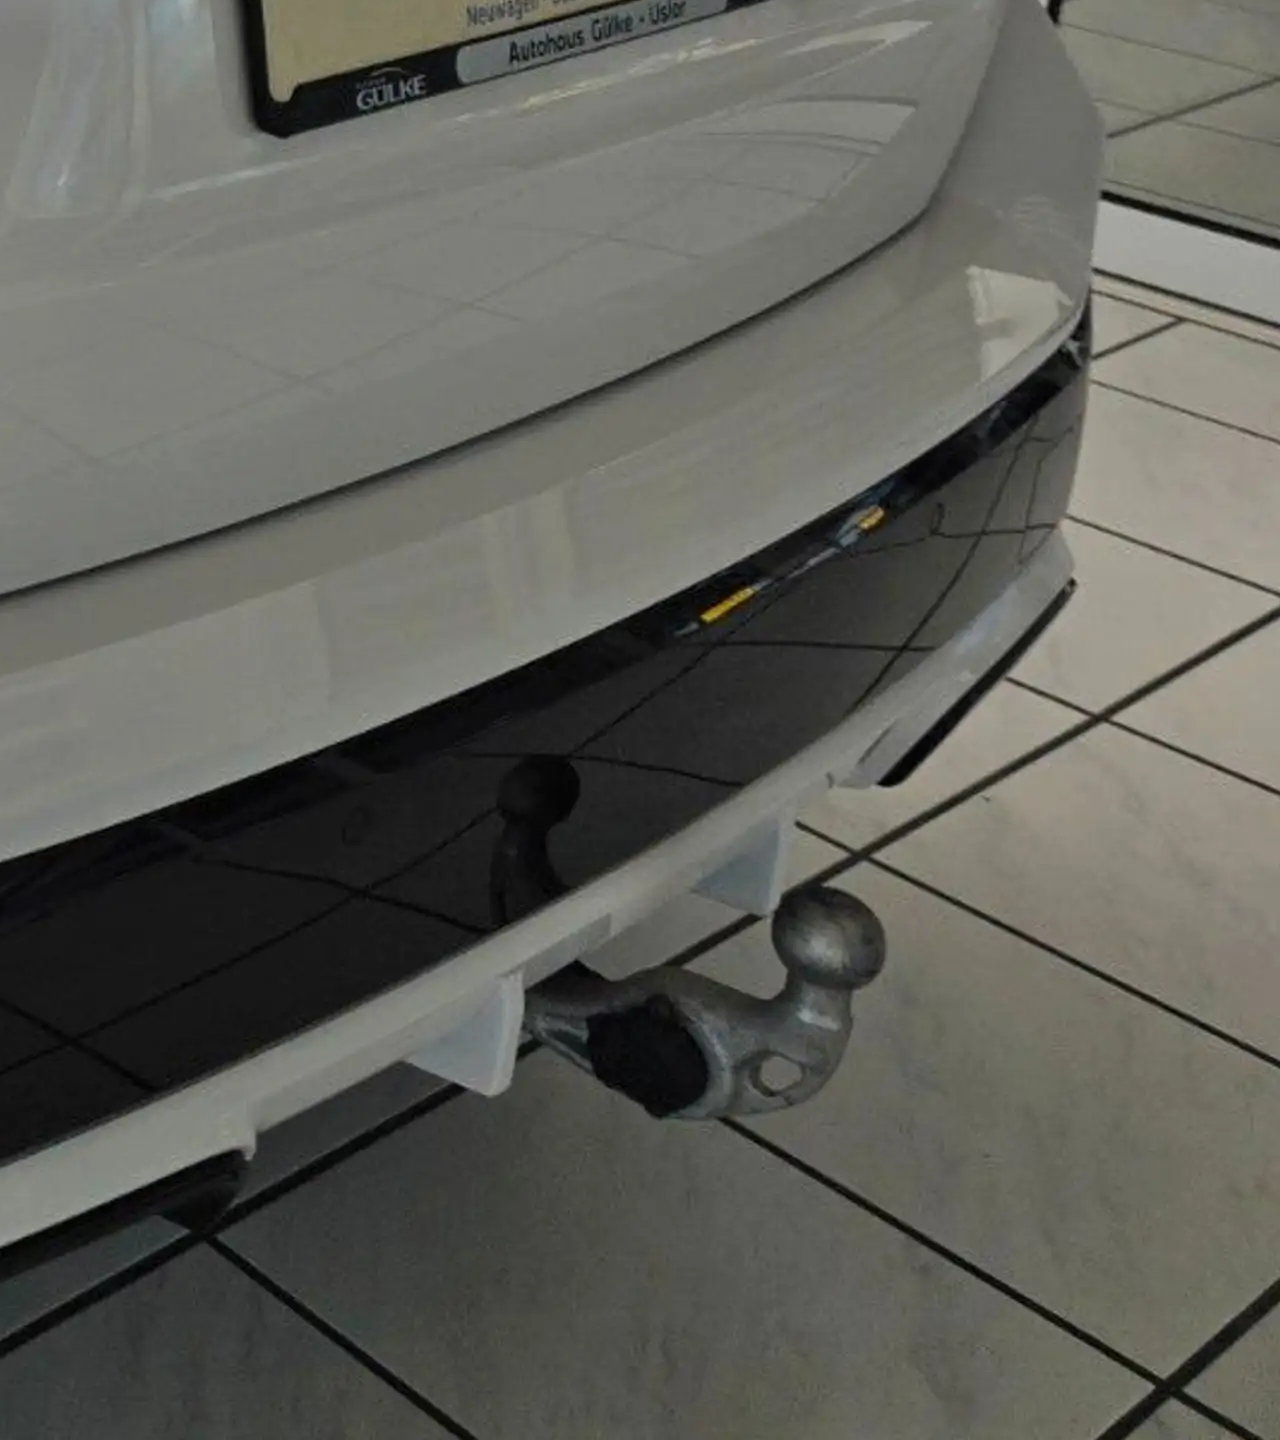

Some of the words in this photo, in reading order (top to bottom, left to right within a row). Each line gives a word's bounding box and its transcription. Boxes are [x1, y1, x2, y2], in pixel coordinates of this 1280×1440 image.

[509, 31, 586, 64] Autohaus
[591, 14, 634, 41] Gülke
[356, 73, 428, 110] GÜLKE
